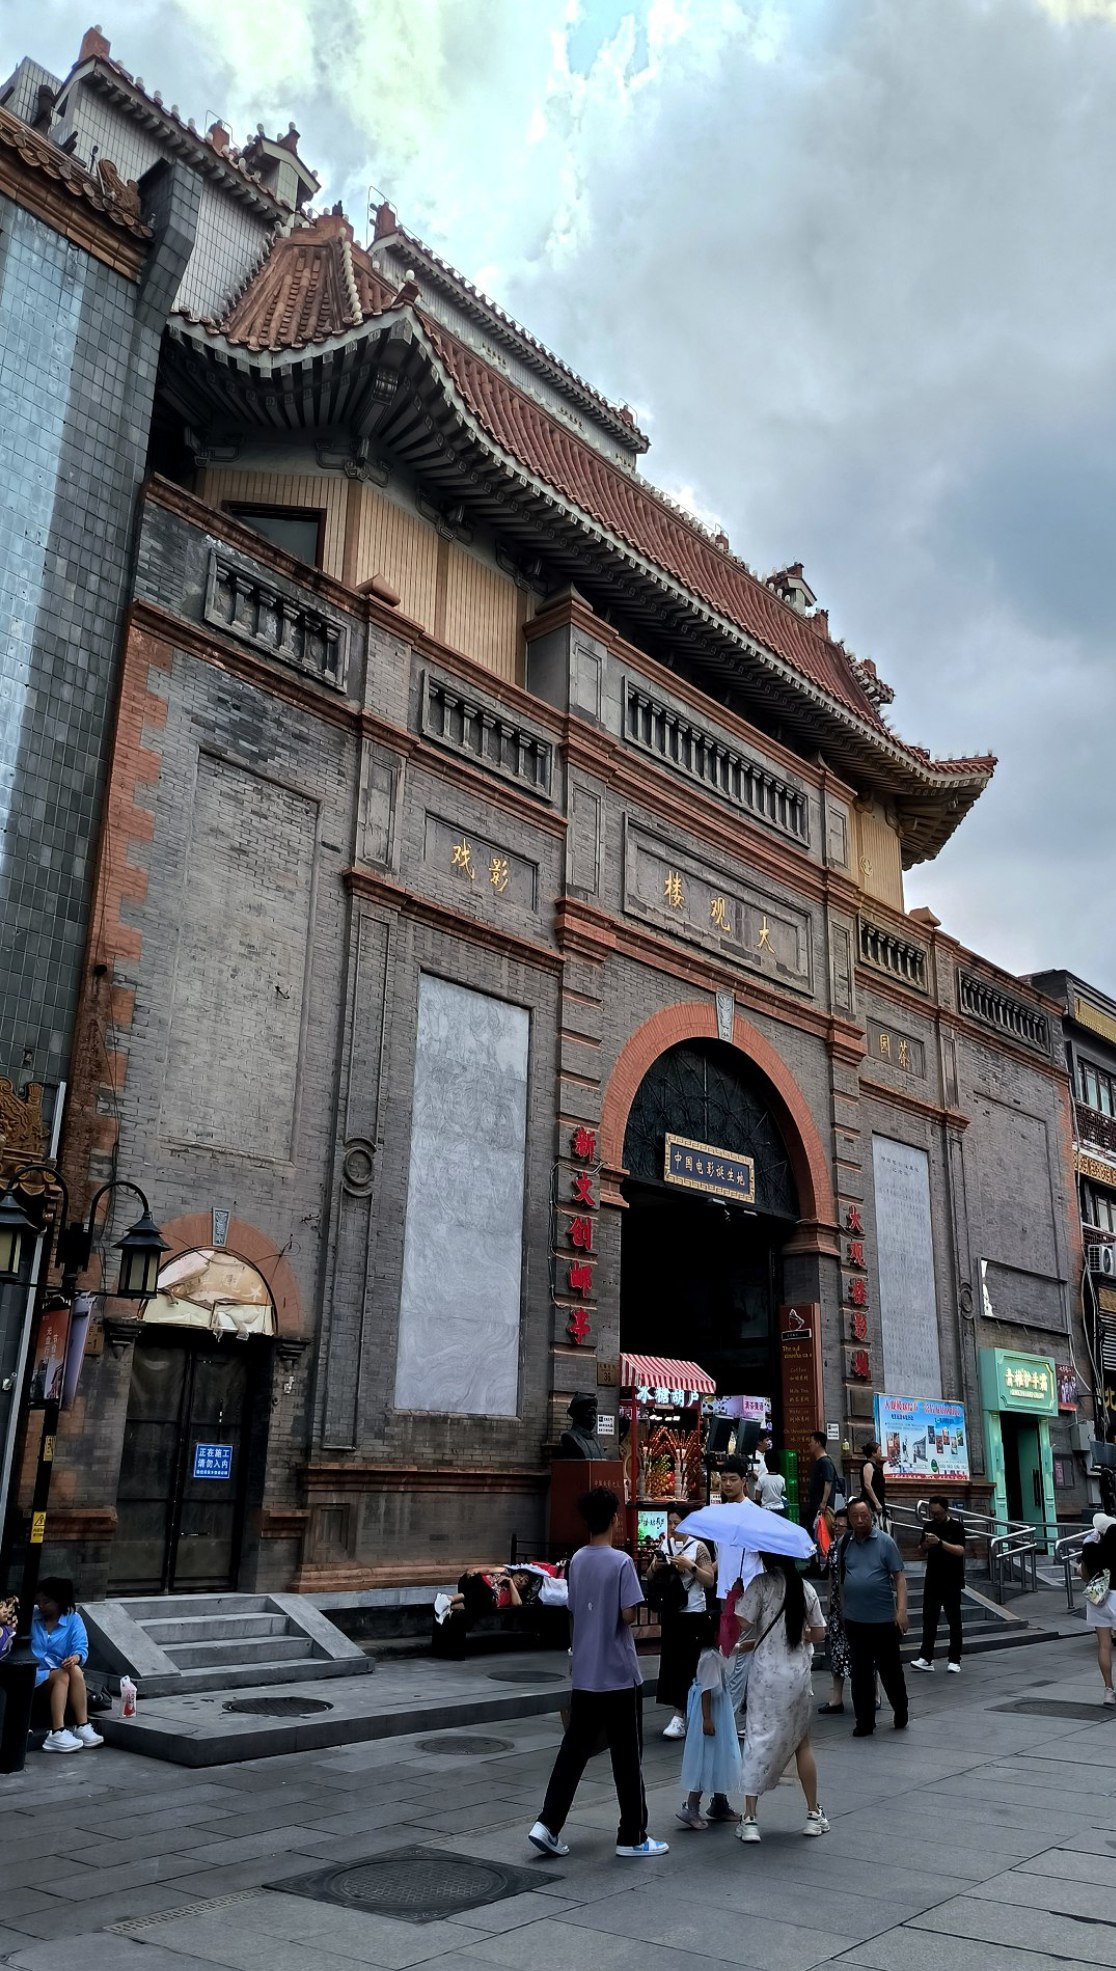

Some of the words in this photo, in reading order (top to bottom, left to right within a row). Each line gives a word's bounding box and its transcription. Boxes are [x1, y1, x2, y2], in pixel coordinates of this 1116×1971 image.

[673, 1150, 746, 1186] 中国电影诞生地
[199, 1447, 230, 1458] 正在施工
[197, 1458, 229, 1469] 请勿入内
